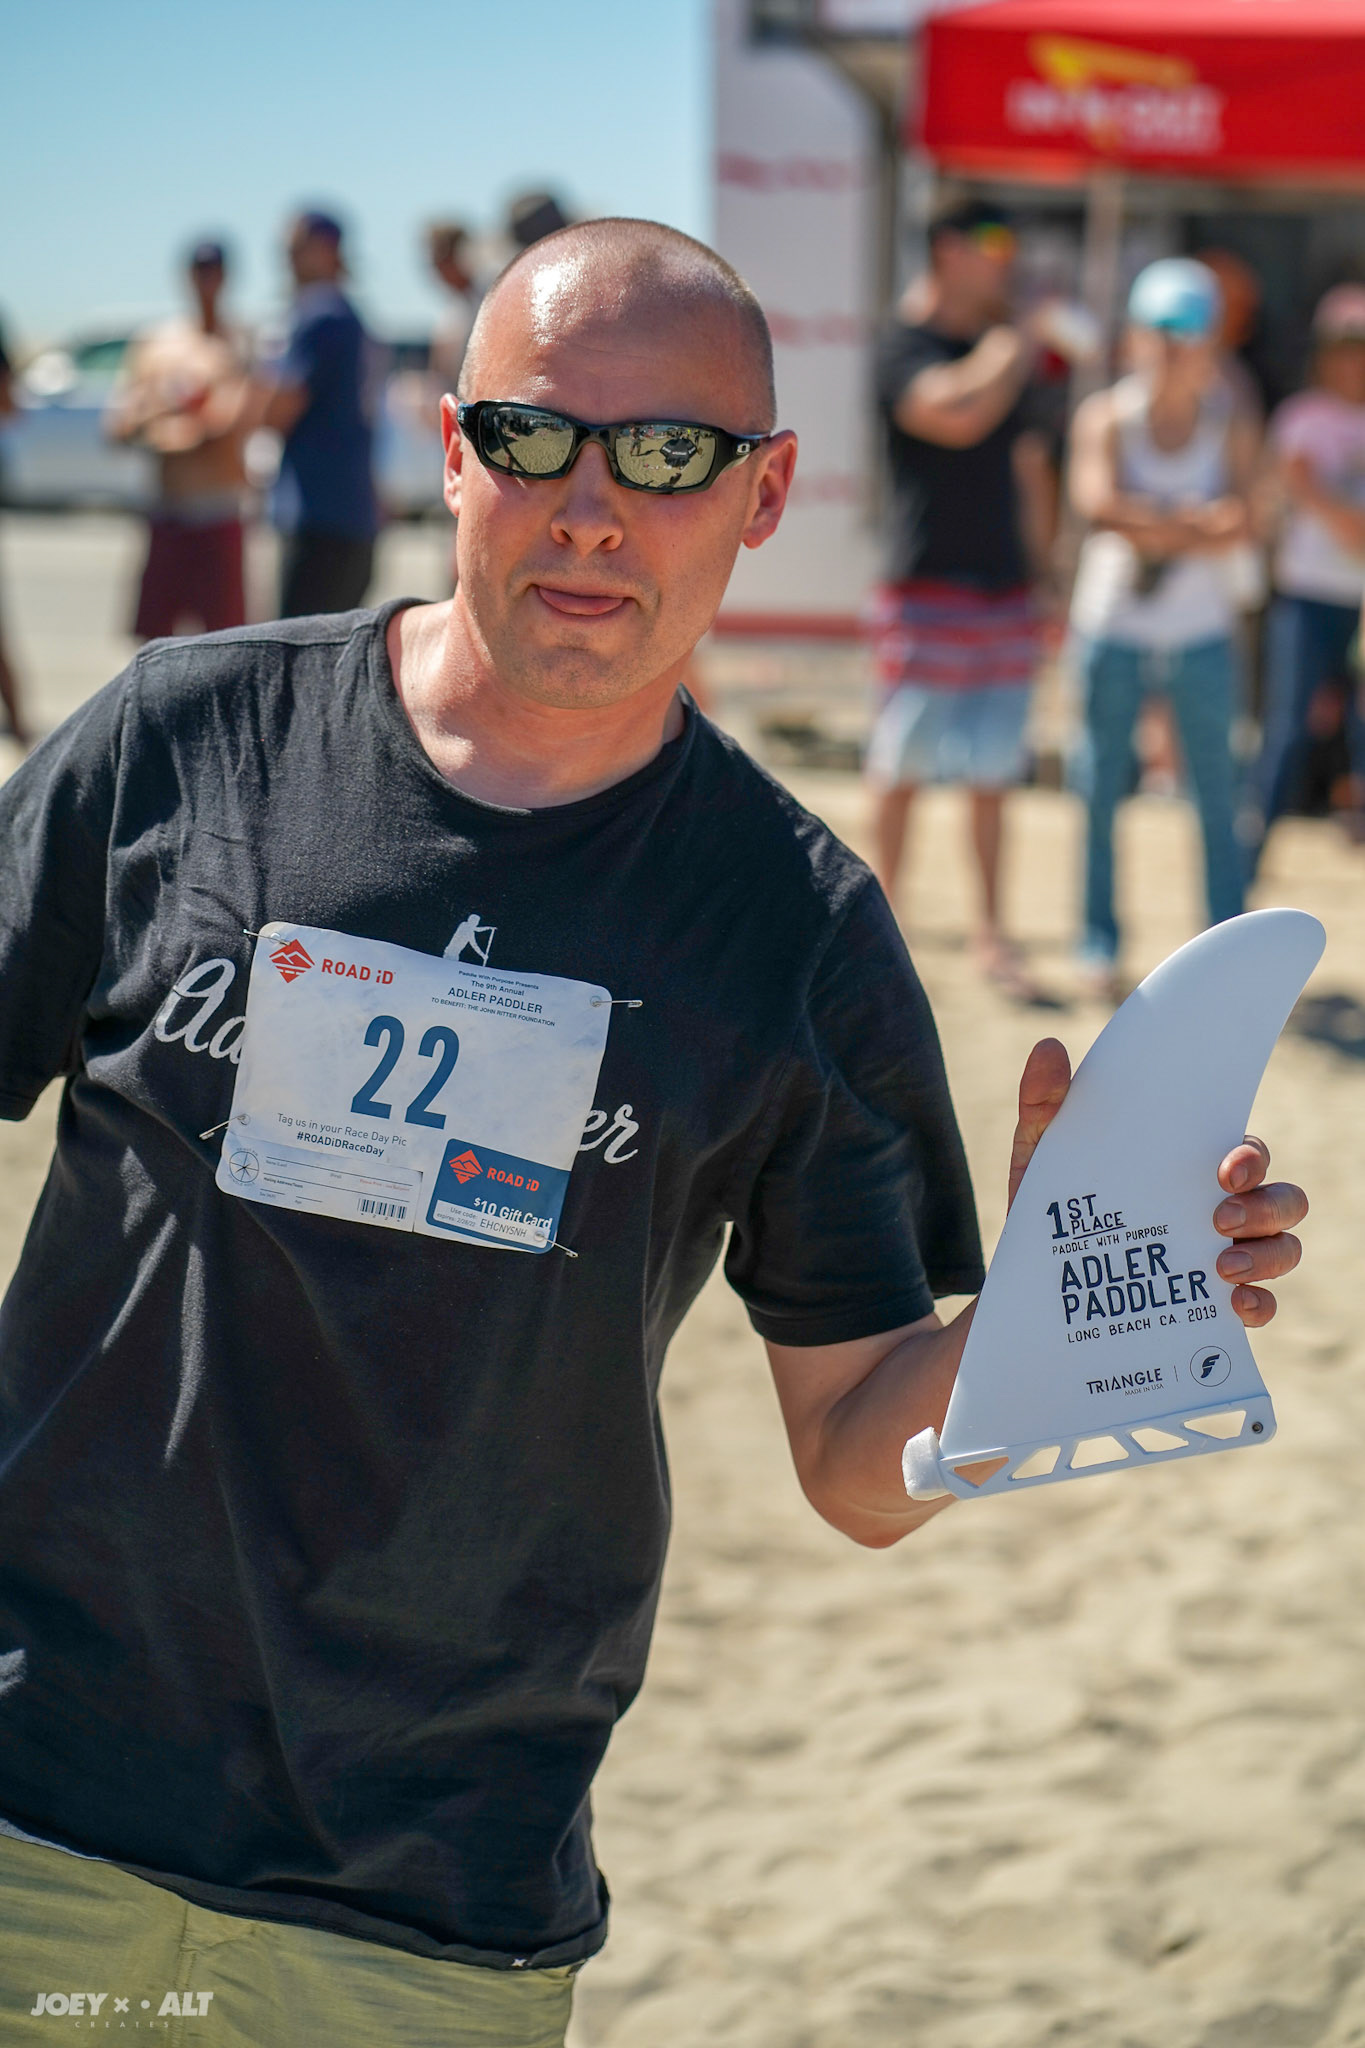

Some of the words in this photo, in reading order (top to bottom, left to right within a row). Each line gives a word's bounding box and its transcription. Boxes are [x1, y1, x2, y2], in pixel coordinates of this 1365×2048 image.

[321, 959, 371, 981] ROAD
[459, 970, 477, 978] Paddle
[492, 976, 514, 985] Purpose
[515, 981, 539, 990] Presents
[447, 987, 487, 1003] ADLER
[489, 995, 543, 1014] PADDLER
[471, 980, 484, 988] The
[486, 983, 497, 991] 9th
[499, 986, 524, 996] Annual
[440, 999, 467, 1009] BENEFIT:
[496, 1010, 517, 1019] RITTER
[517, 1014, 555, 1027] FOUNDATION
[350, 1015, 460, 1130] 22
[277, 1112, 293, 1127] Tag
[295, 1119, 307, 1128] us
[309, 1120, 318, 1130] in
[320, 1124, 343, 1134] your
[344, 1126, 369, 1139] Race
[371, 1131, 390, 1145] Day
[392, 1135, 408, 1147] Pic
[296, 1131, 385, 1158] #ROADiDRaceDay
[486, 1167, 524, 1188] ROAD
[450, 1207, 461, 1215] Use
[473, 1197, 497, 1216] $10
[499, 1206, 523, 1223] Gift
[523, 1212, 553, 1230] Card
[1071, 1211, 1124, 1235] PLACE
[1052, 1240, 1089, 1255] PADDLE
[1096, 1234, 1120, 1247] WITH
[1126, 1225, 1169, 1242] PURPOSE
[1061, 1243, 1170, 1293] ADLER
[1062, 1270, 1210, 1324] PADDLER
[1067, 1328, 1101, 1343] LONG
[1109, 1318, 1151, 1336] BEACH
[1187, 1304, 1217, 1322] 2019
[1086, 1368, 1163, 1395] TRIANGLE
[1124, 1388, 1142, 1396] MADE
[1151, 1383, 1164, 1391] USA
